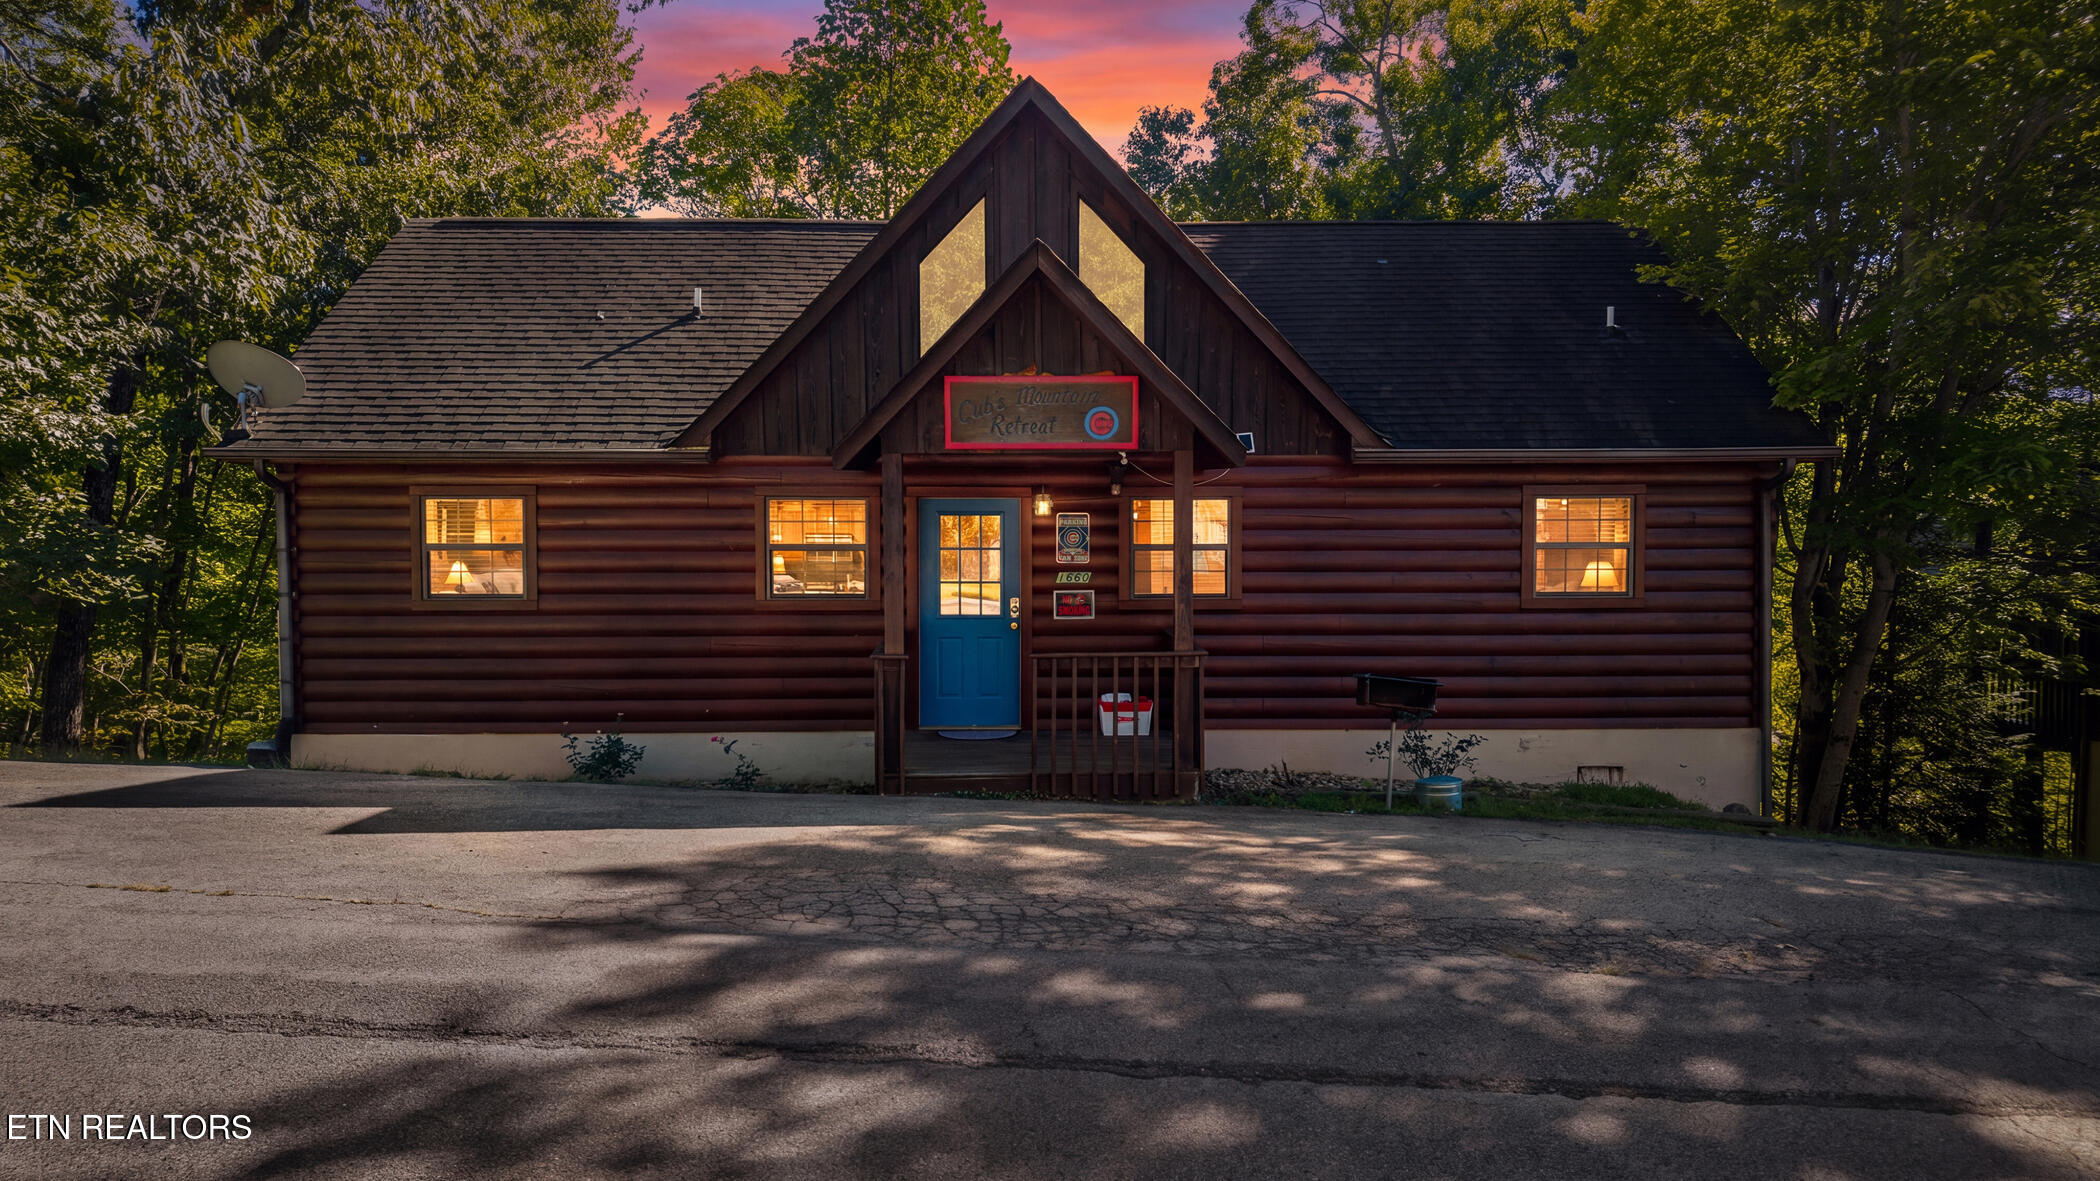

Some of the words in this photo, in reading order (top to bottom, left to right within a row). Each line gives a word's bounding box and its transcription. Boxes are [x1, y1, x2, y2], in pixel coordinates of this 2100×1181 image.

[959, 389, 1007, 424] Cub's
[1015, 386, 1101, 406] Mountain
[990, 415, 1058, 436] Retreat
[1060, 573, 1090, 582] 1660
[1062, 594, 1073, 605] NO
[1058, 604, 1091, 616] SMOKING
